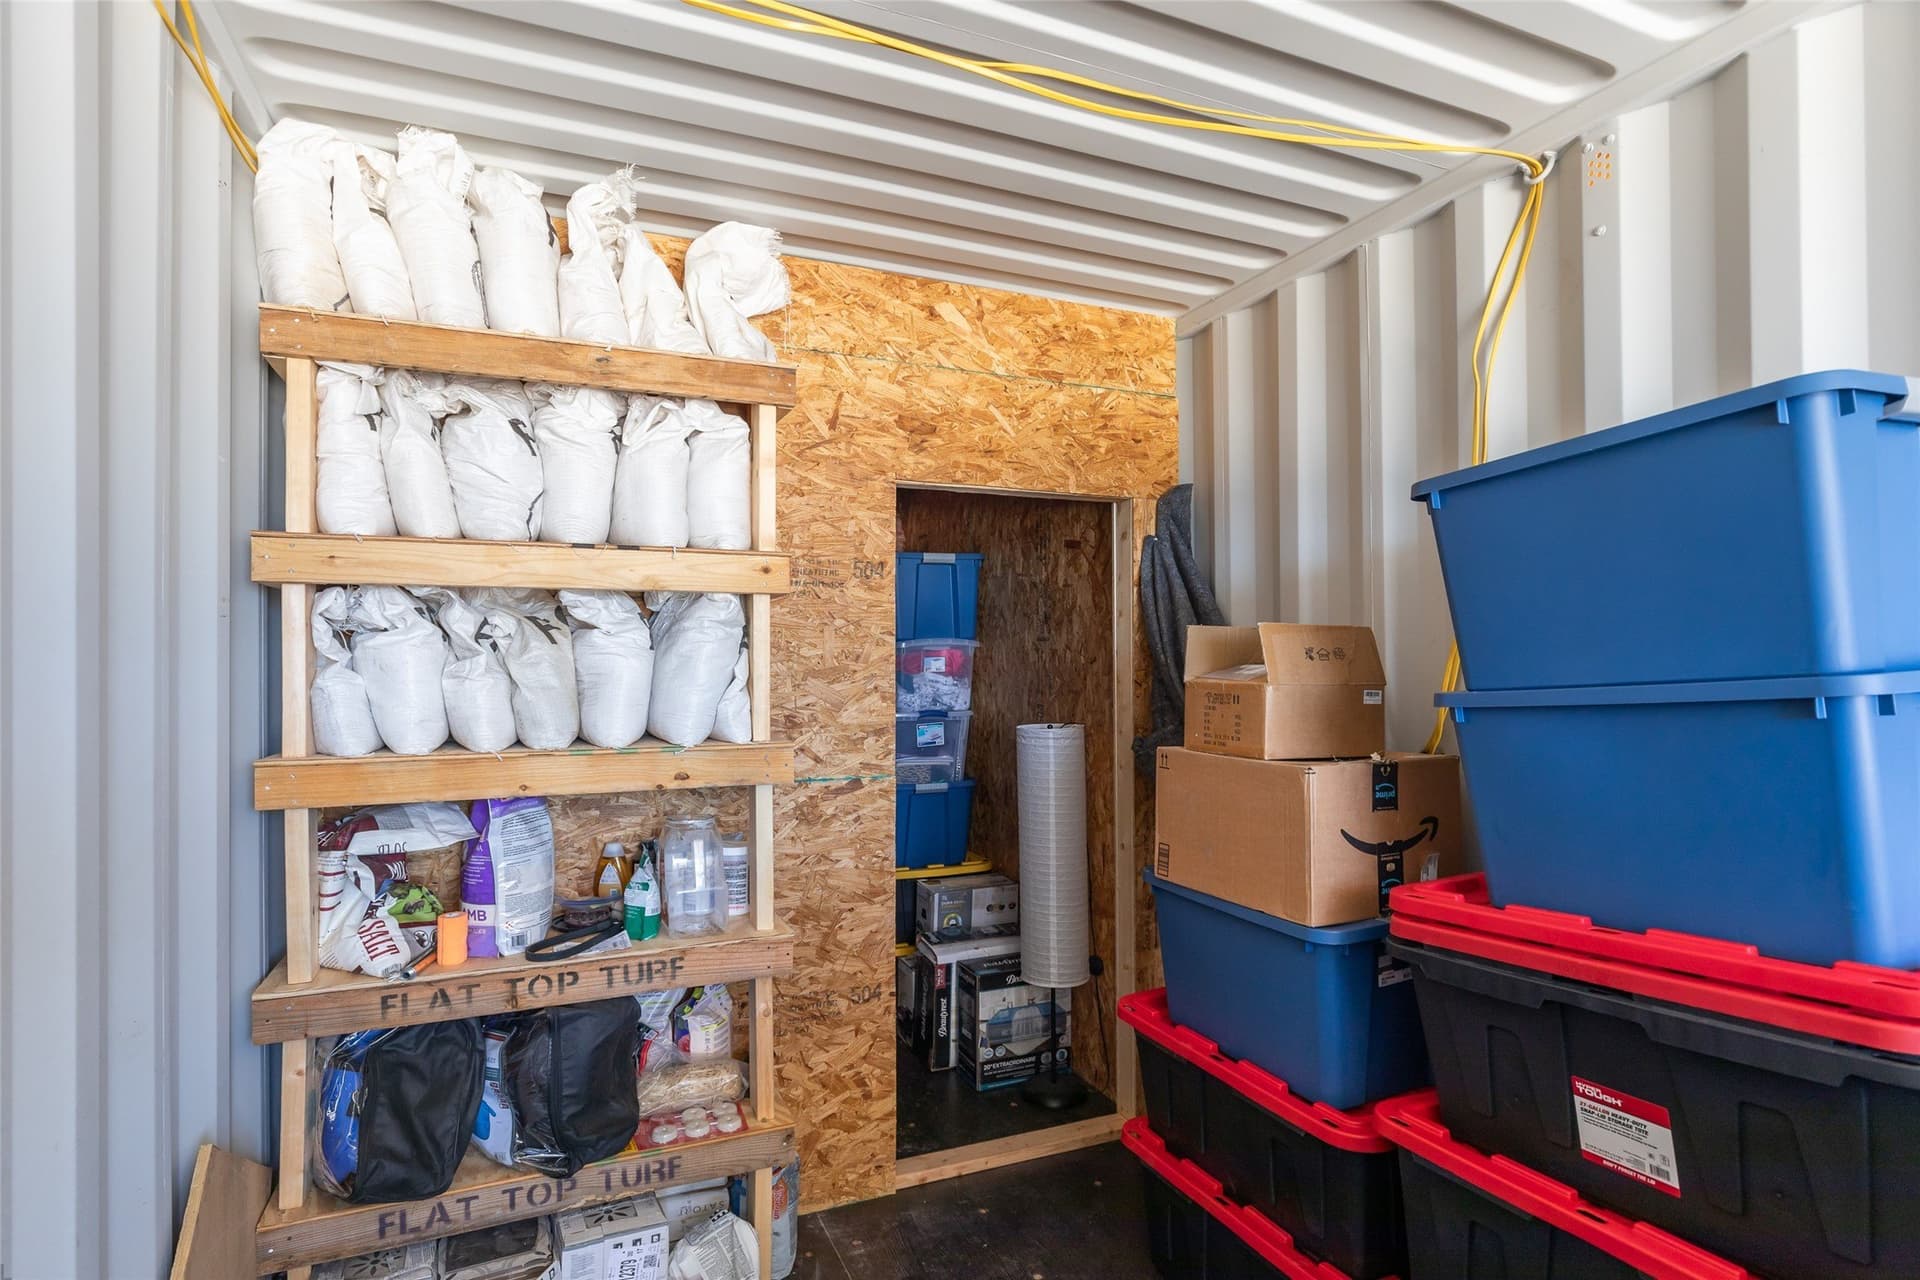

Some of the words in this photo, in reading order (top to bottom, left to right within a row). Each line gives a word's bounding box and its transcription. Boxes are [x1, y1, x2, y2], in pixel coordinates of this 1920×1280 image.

[852, 560, 884, 579] 504
[1376, 790, 1395, 800] prime
[357, 919, 400, 962] SALT
[380, 983, 481, 1020] FLAT
[503, 970, 580, 1000] TOP
[600, 956, 685, 989] TURF
[1577, 1084, 1622, 1107] TOUGH
[378, 1195, 479, 1240] FLAT
[502, 1177, 578, 1211] TOP
[600, 1156, 683, 1192] TURF
